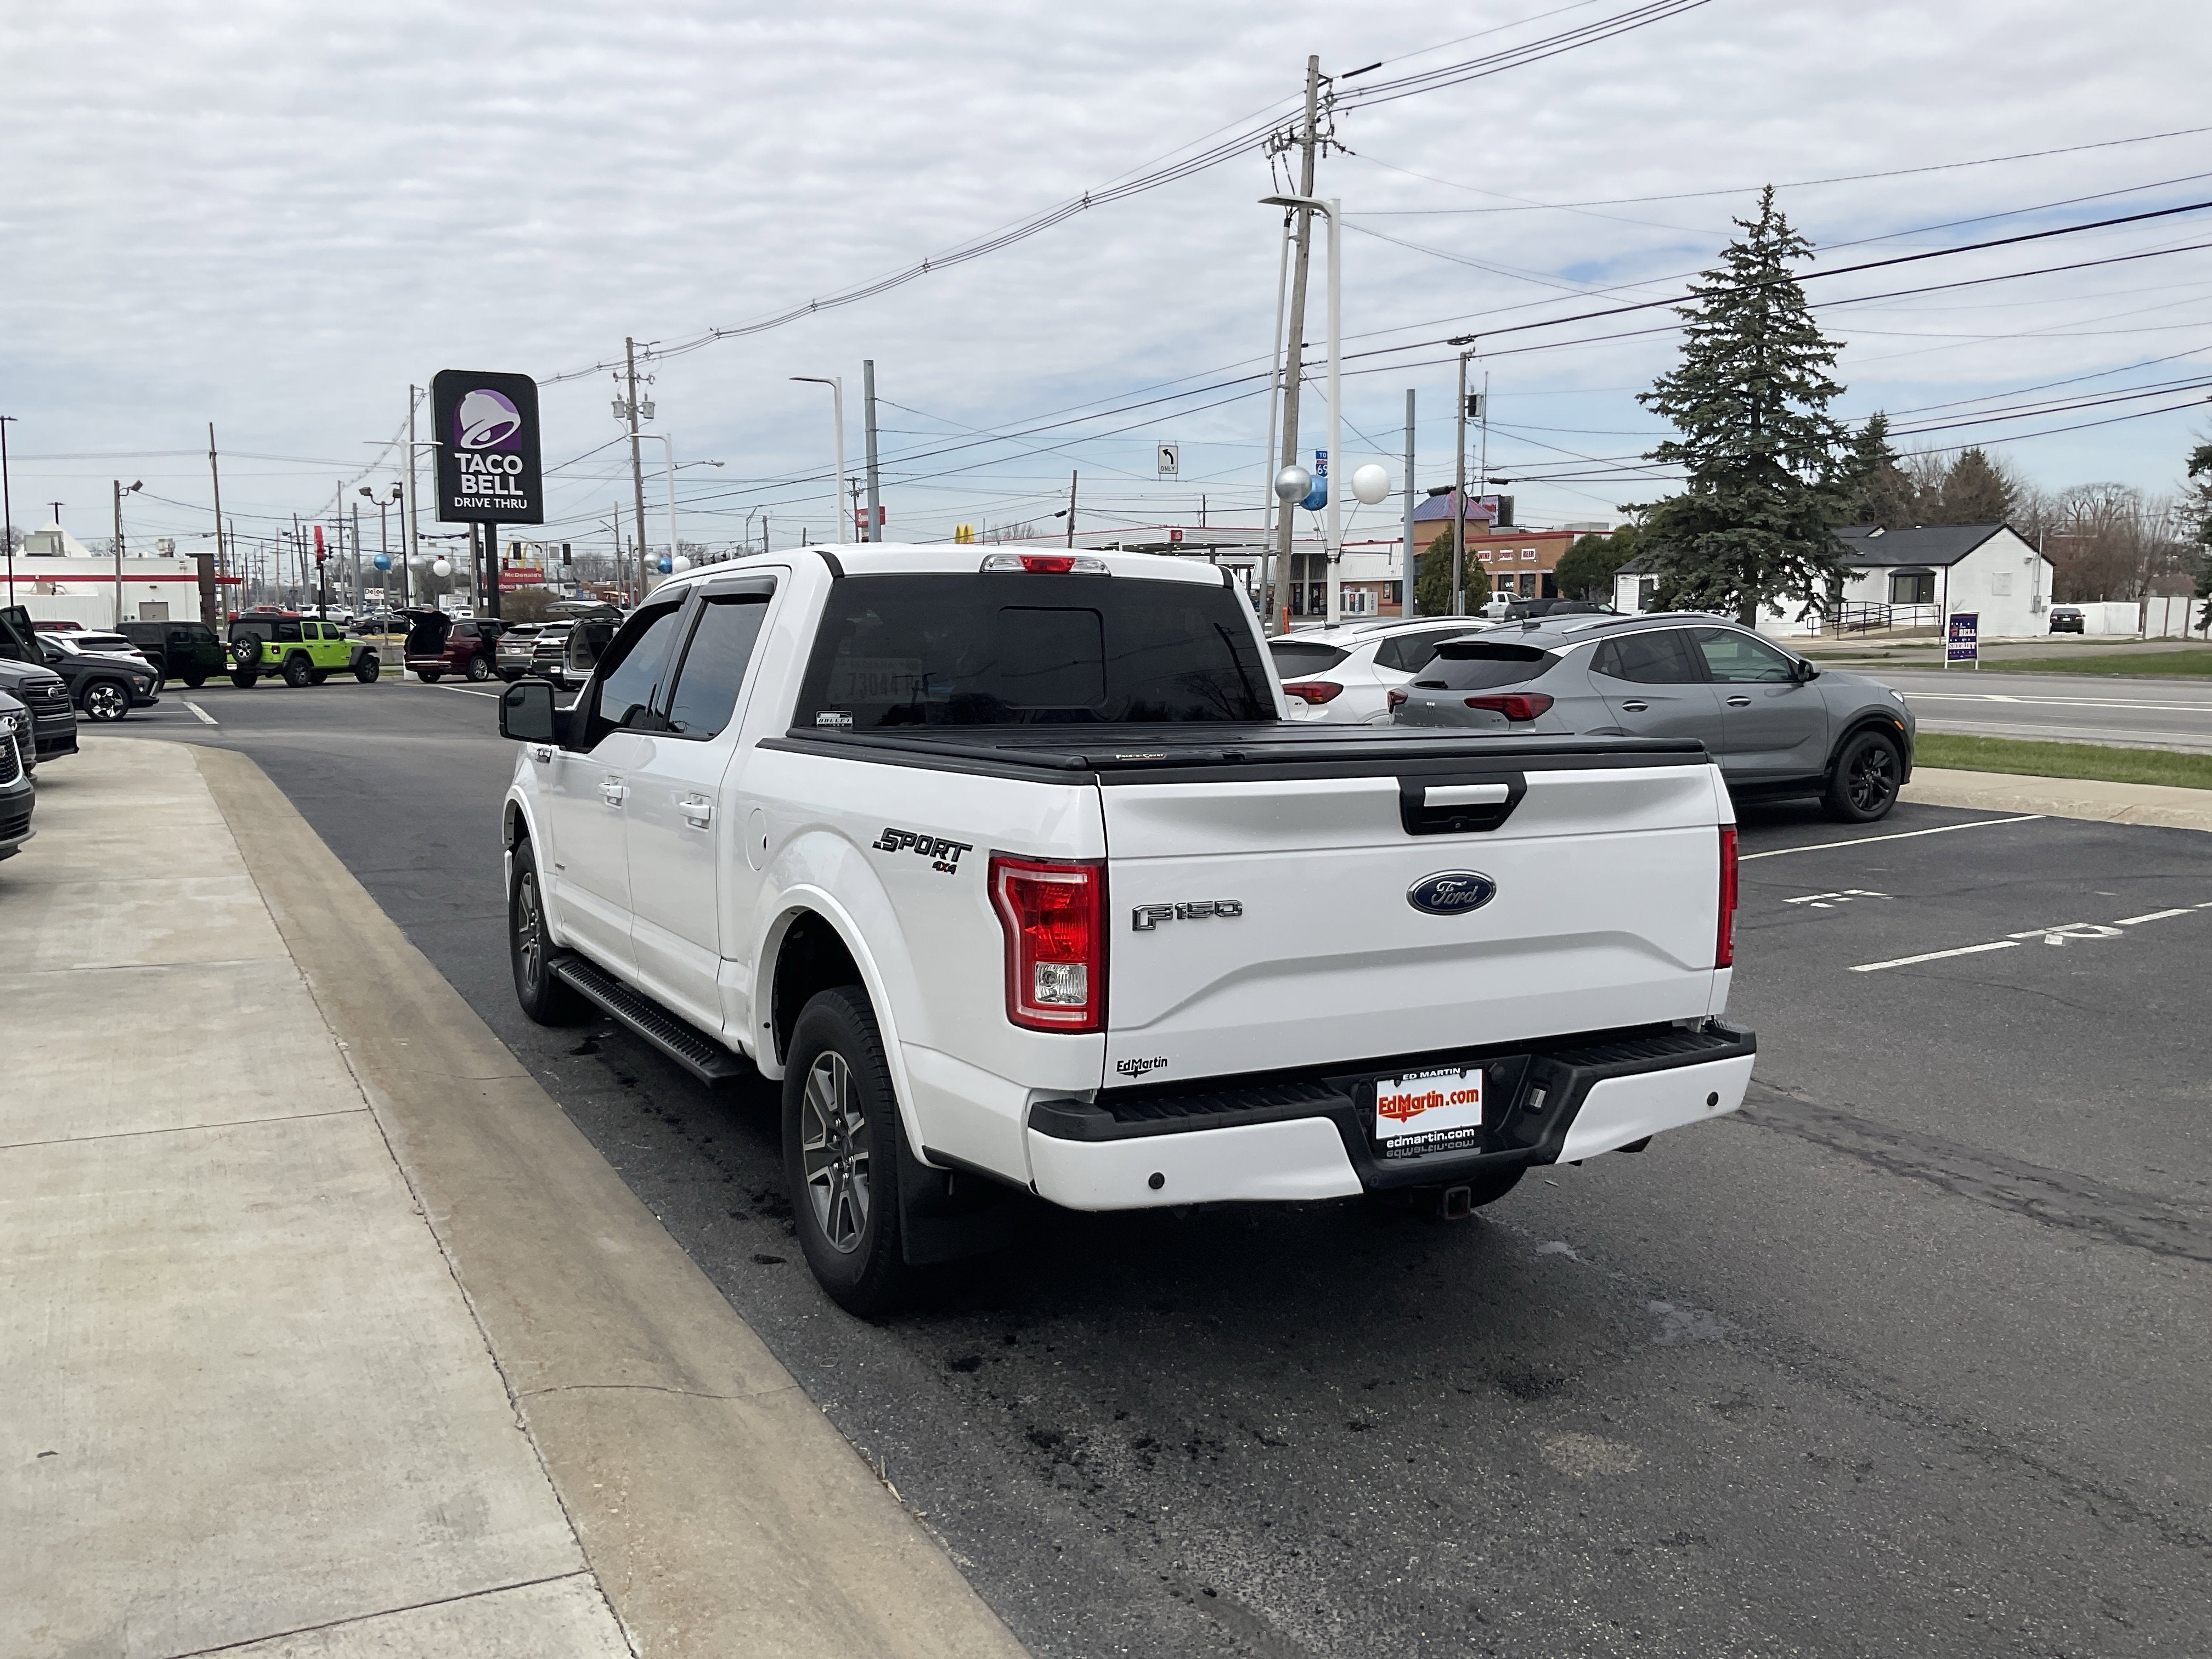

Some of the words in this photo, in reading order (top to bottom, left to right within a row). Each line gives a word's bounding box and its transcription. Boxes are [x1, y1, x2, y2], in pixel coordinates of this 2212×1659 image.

[455, 453, 523, 475] TACO
[461, 475, 523, 495] BELL
[455, 497, 491, 508] DRIVE
[494, 498, 527, 509] THRU
[872, 827, 973, 862] SPORT
[1430, 881, 1479, 906] Ford
[1420, 1068, 1461, 1079] MARTIN
[1386, 1128, 1475, 1148] edmartin.com
